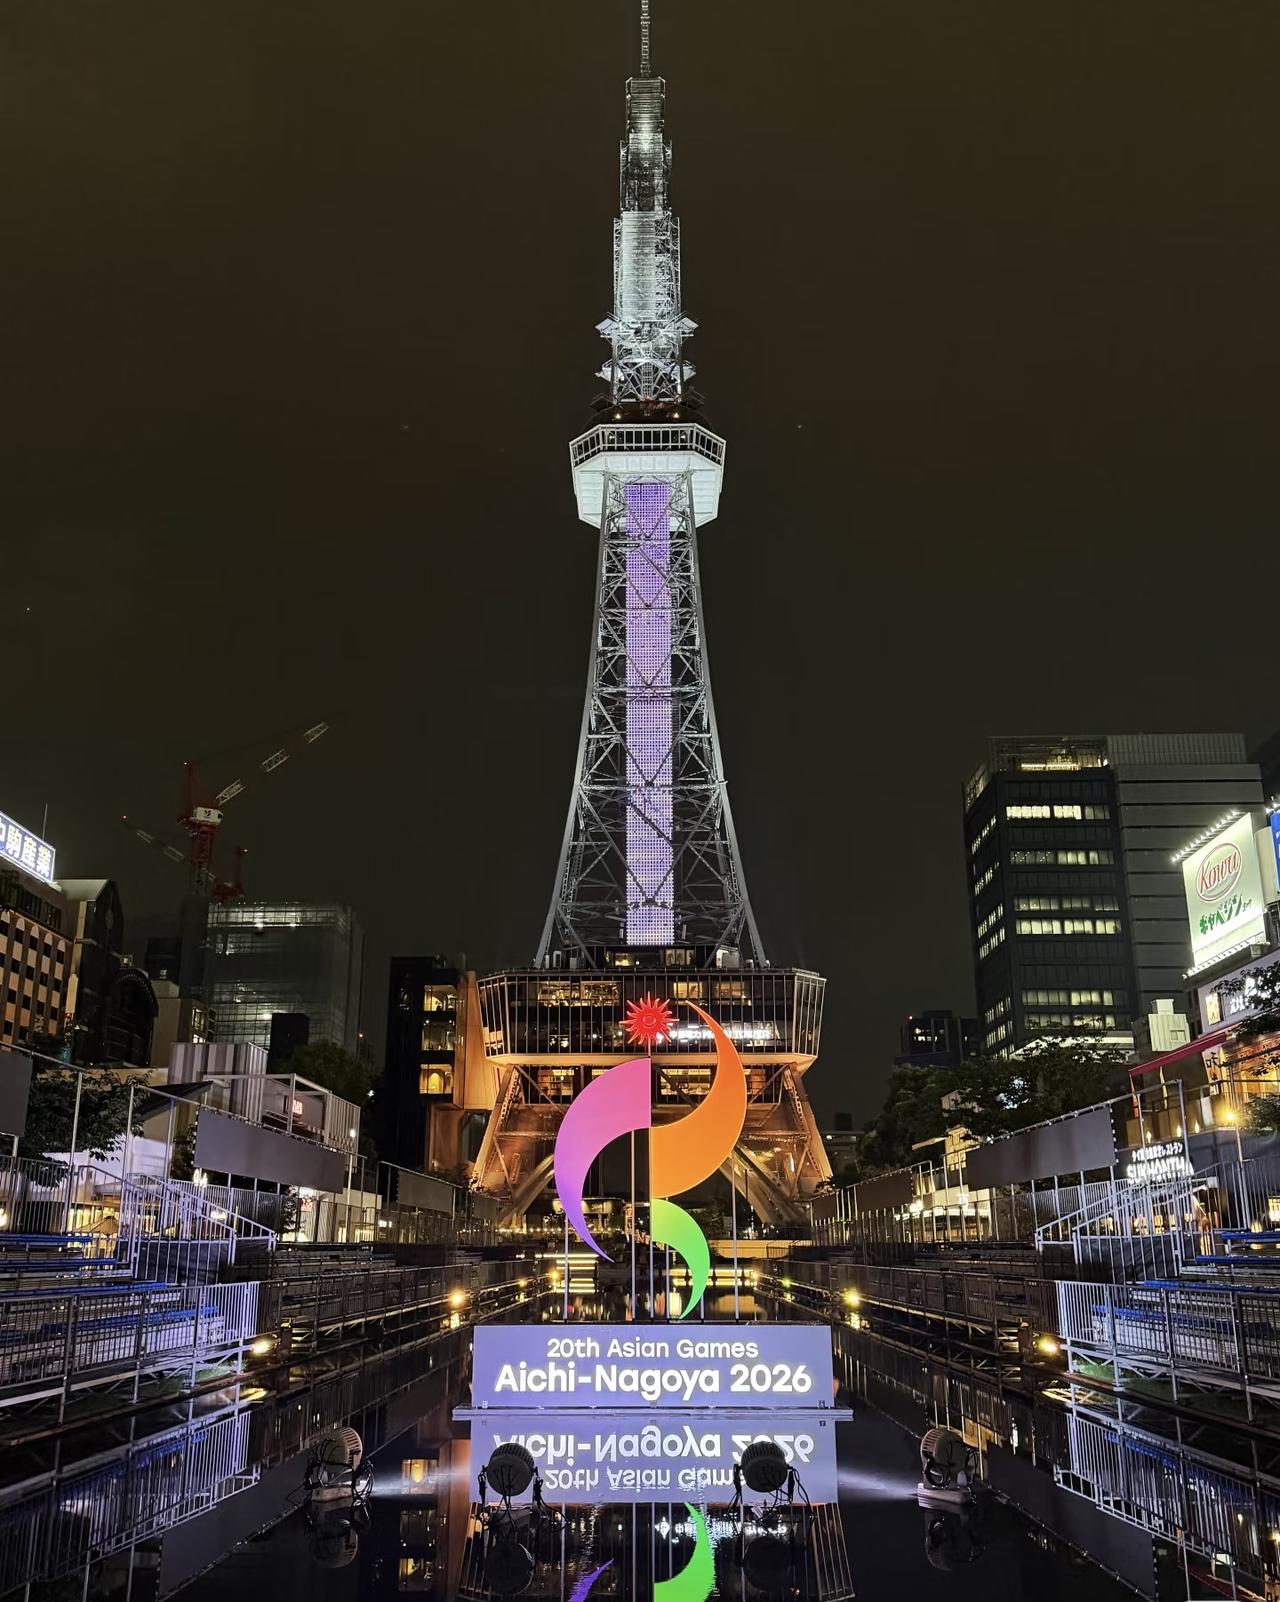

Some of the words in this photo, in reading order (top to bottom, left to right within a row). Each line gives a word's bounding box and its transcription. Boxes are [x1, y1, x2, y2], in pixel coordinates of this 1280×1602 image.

[1199, 852, 1239, 894] Kowa
[547, 1337, 600, 1358] 20th
[607, 1337, 669, 1358] Asian
[676, 1338, 759, 1358] Games
[494, 1361, 720, 1401] Aichi-Nagoya
[730, 1363, 812, 1393] 2026
